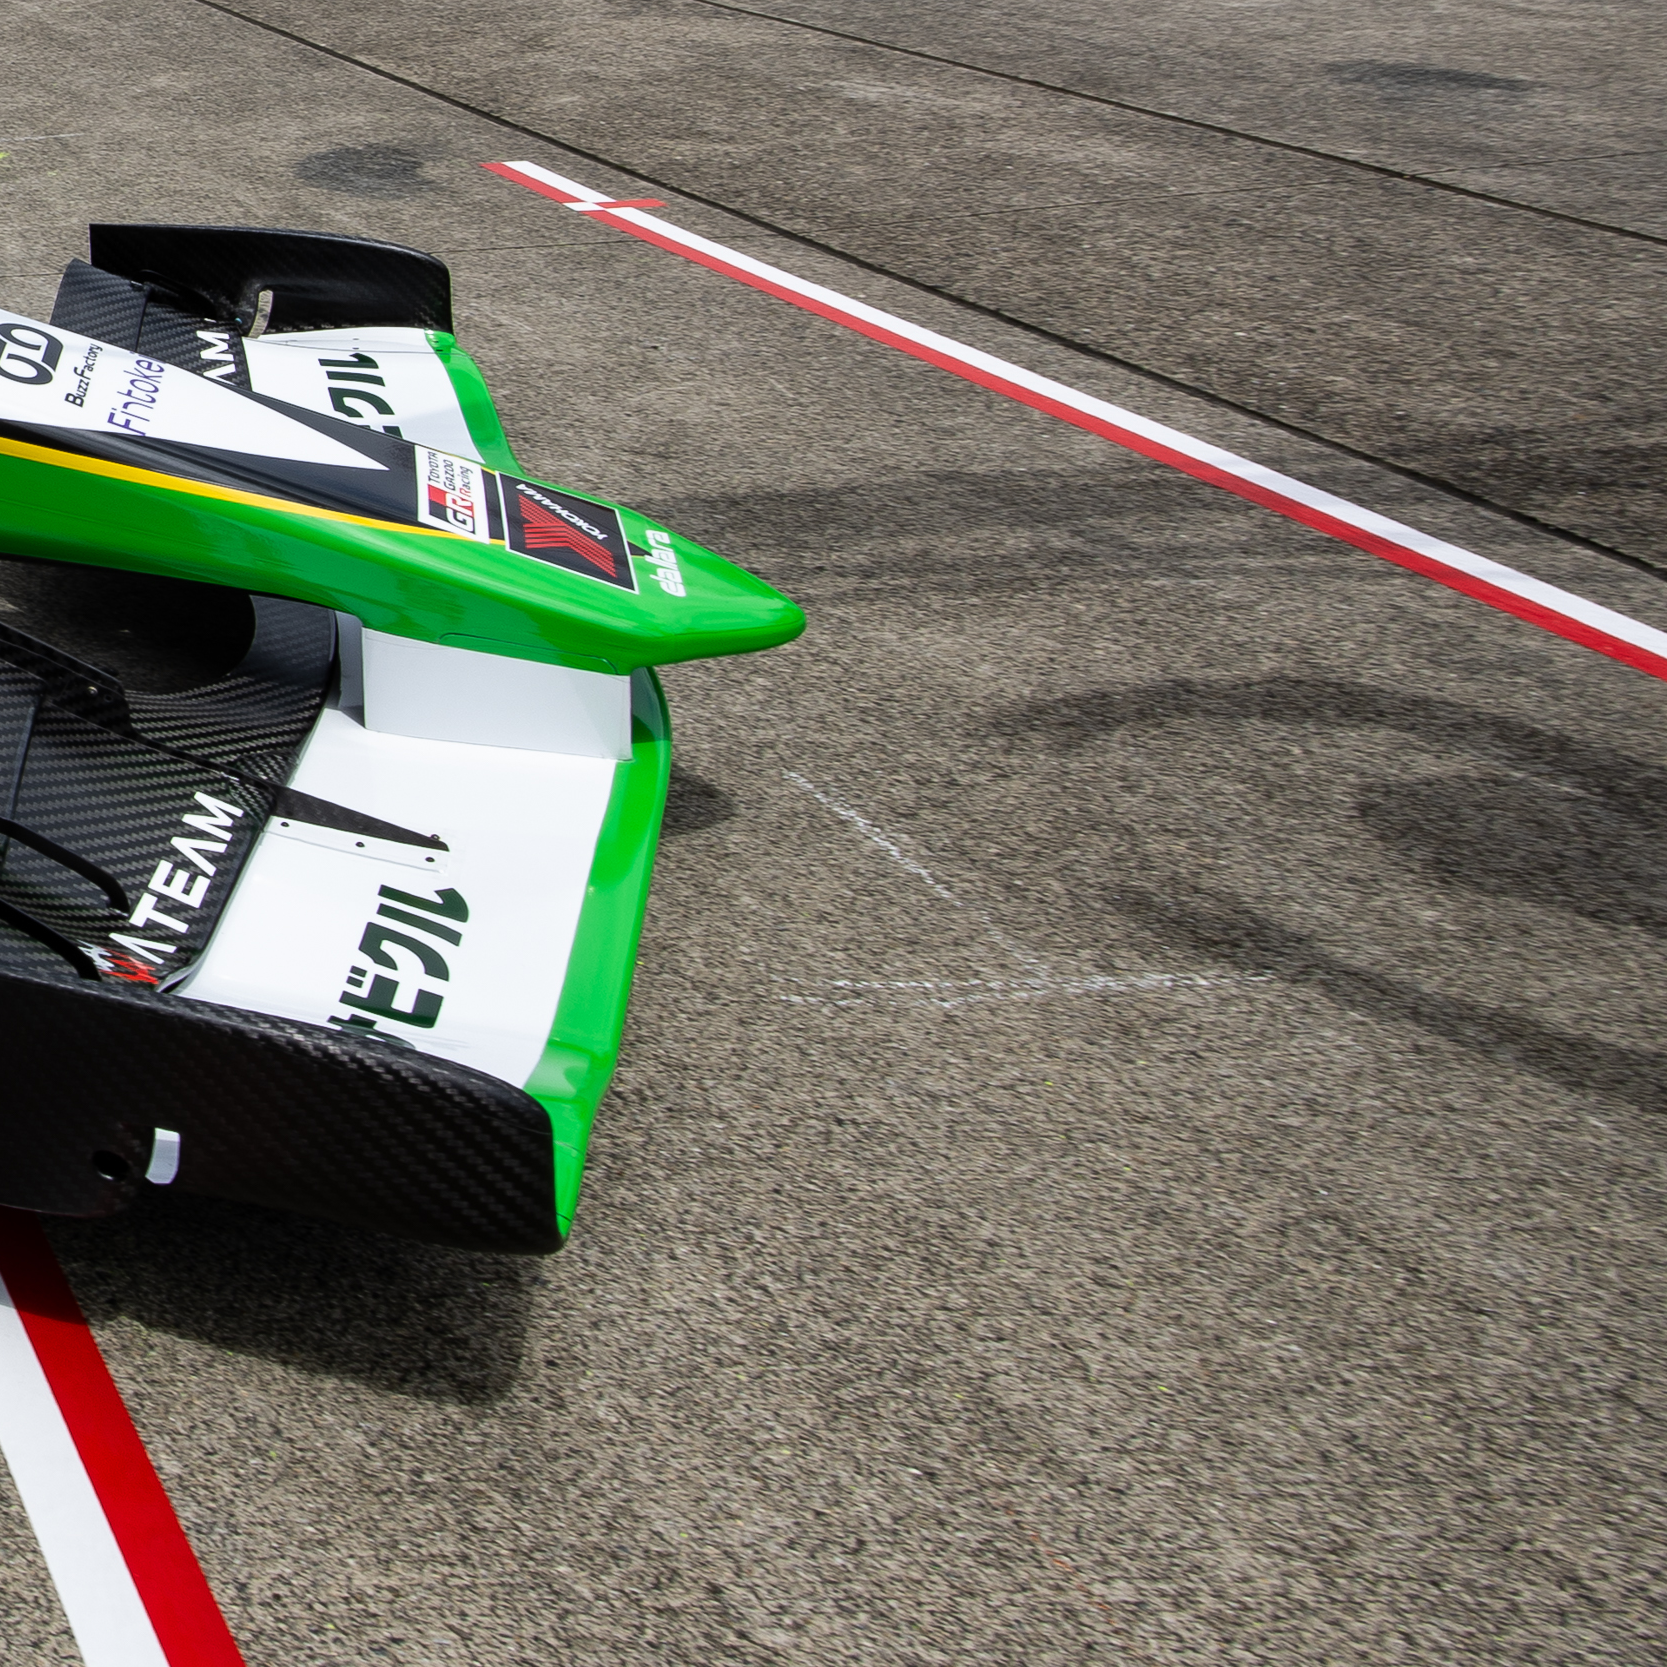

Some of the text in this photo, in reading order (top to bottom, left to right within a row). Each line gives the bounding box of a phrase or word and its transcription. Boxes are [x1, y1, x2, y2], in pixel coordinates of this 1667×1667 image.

[428, 451, 439, 484] TOYOTA
[443, 459, 455, 491] GAZOO
[460, 466, 473, 497] Racing
[446, 489, 476, 534] GR
[516, 483, 608, 540] YOKOHAMA
[109, 791, 244, 965] ATEAM
